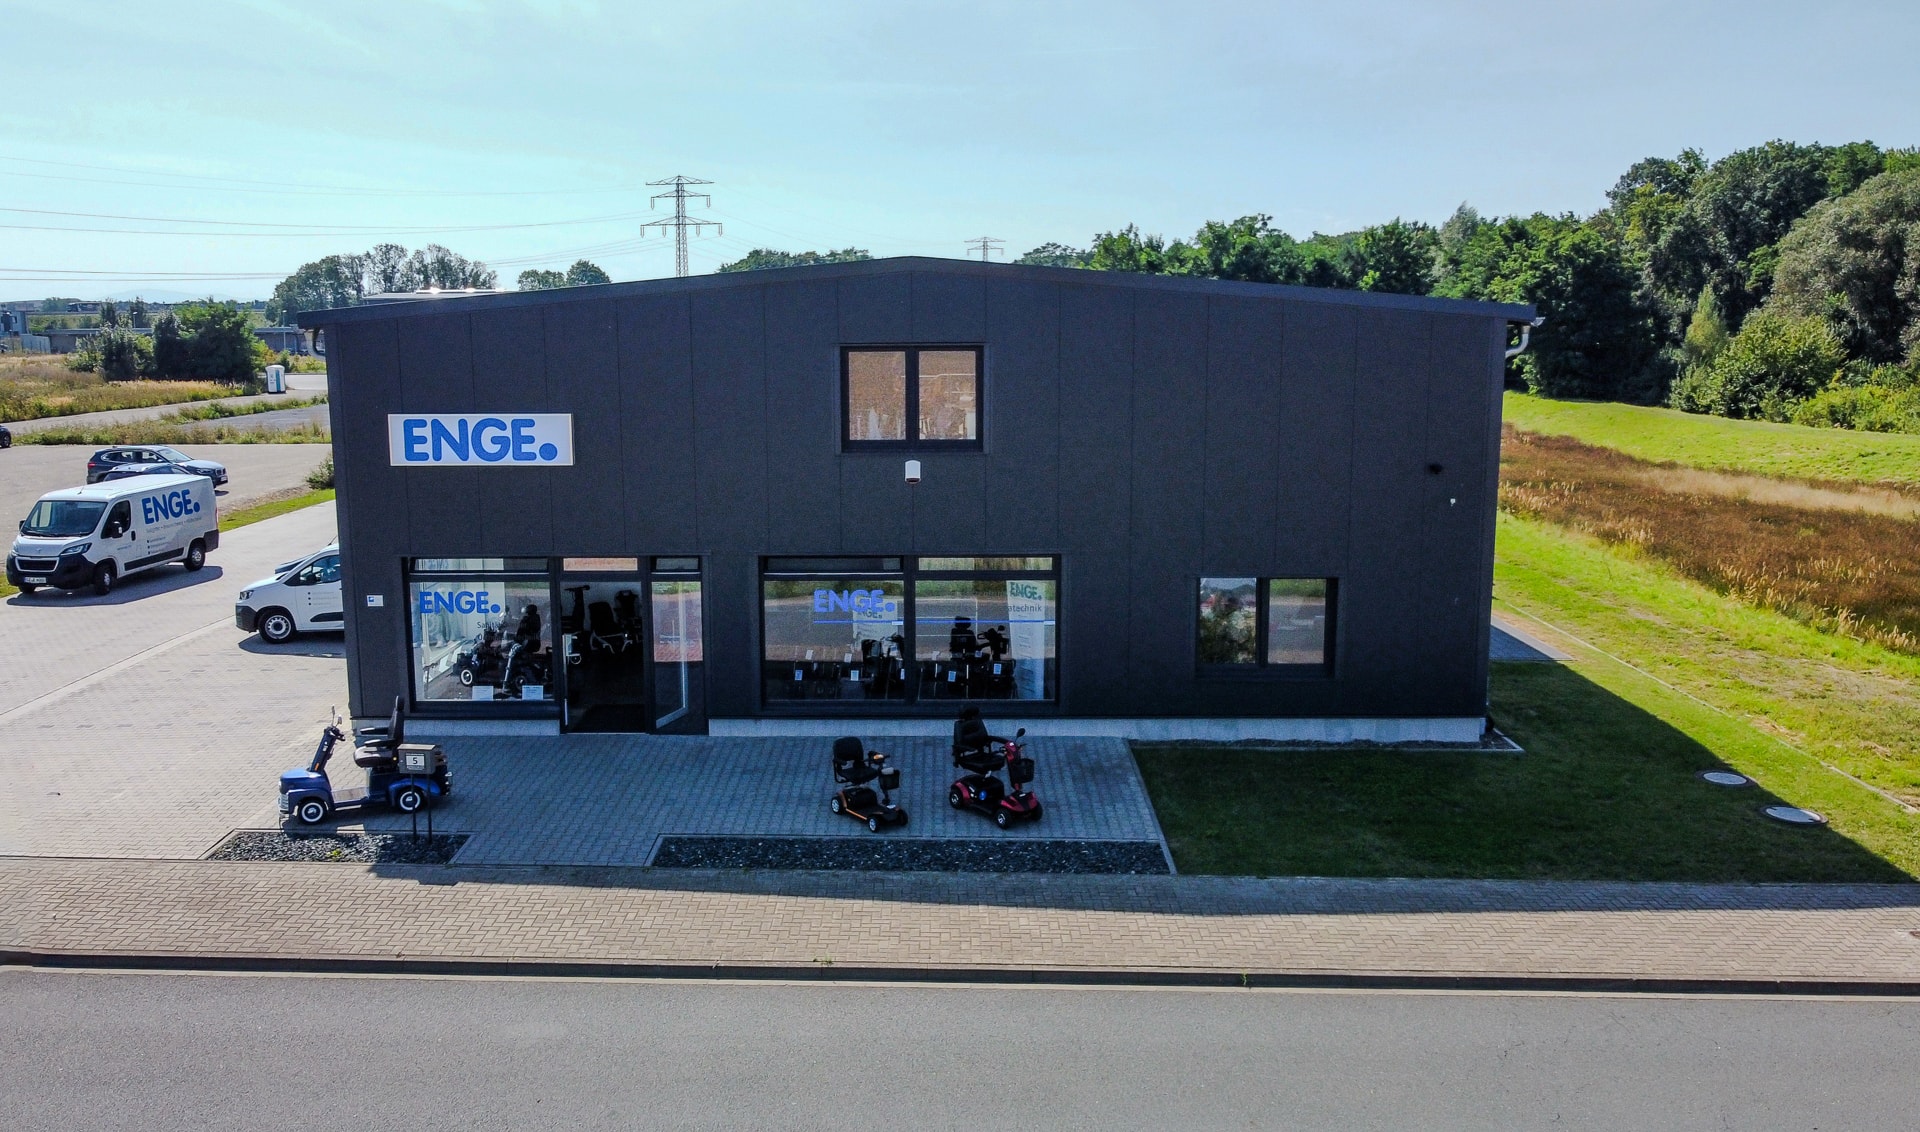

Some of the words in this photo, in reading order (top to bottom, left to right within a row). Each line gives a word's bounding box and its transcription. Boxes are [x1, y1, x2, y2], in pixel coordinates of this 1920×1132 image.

[403, 418, 558, 462] ENGE.
[142, 489, 200, 524] ENGE.
[419, 591, 501, 614] ENGE.
[814, 589, 896, 613] ENGE.
[1010, 582, 1042, 601] ENGE.
[413, 757, 418, 765] 5
